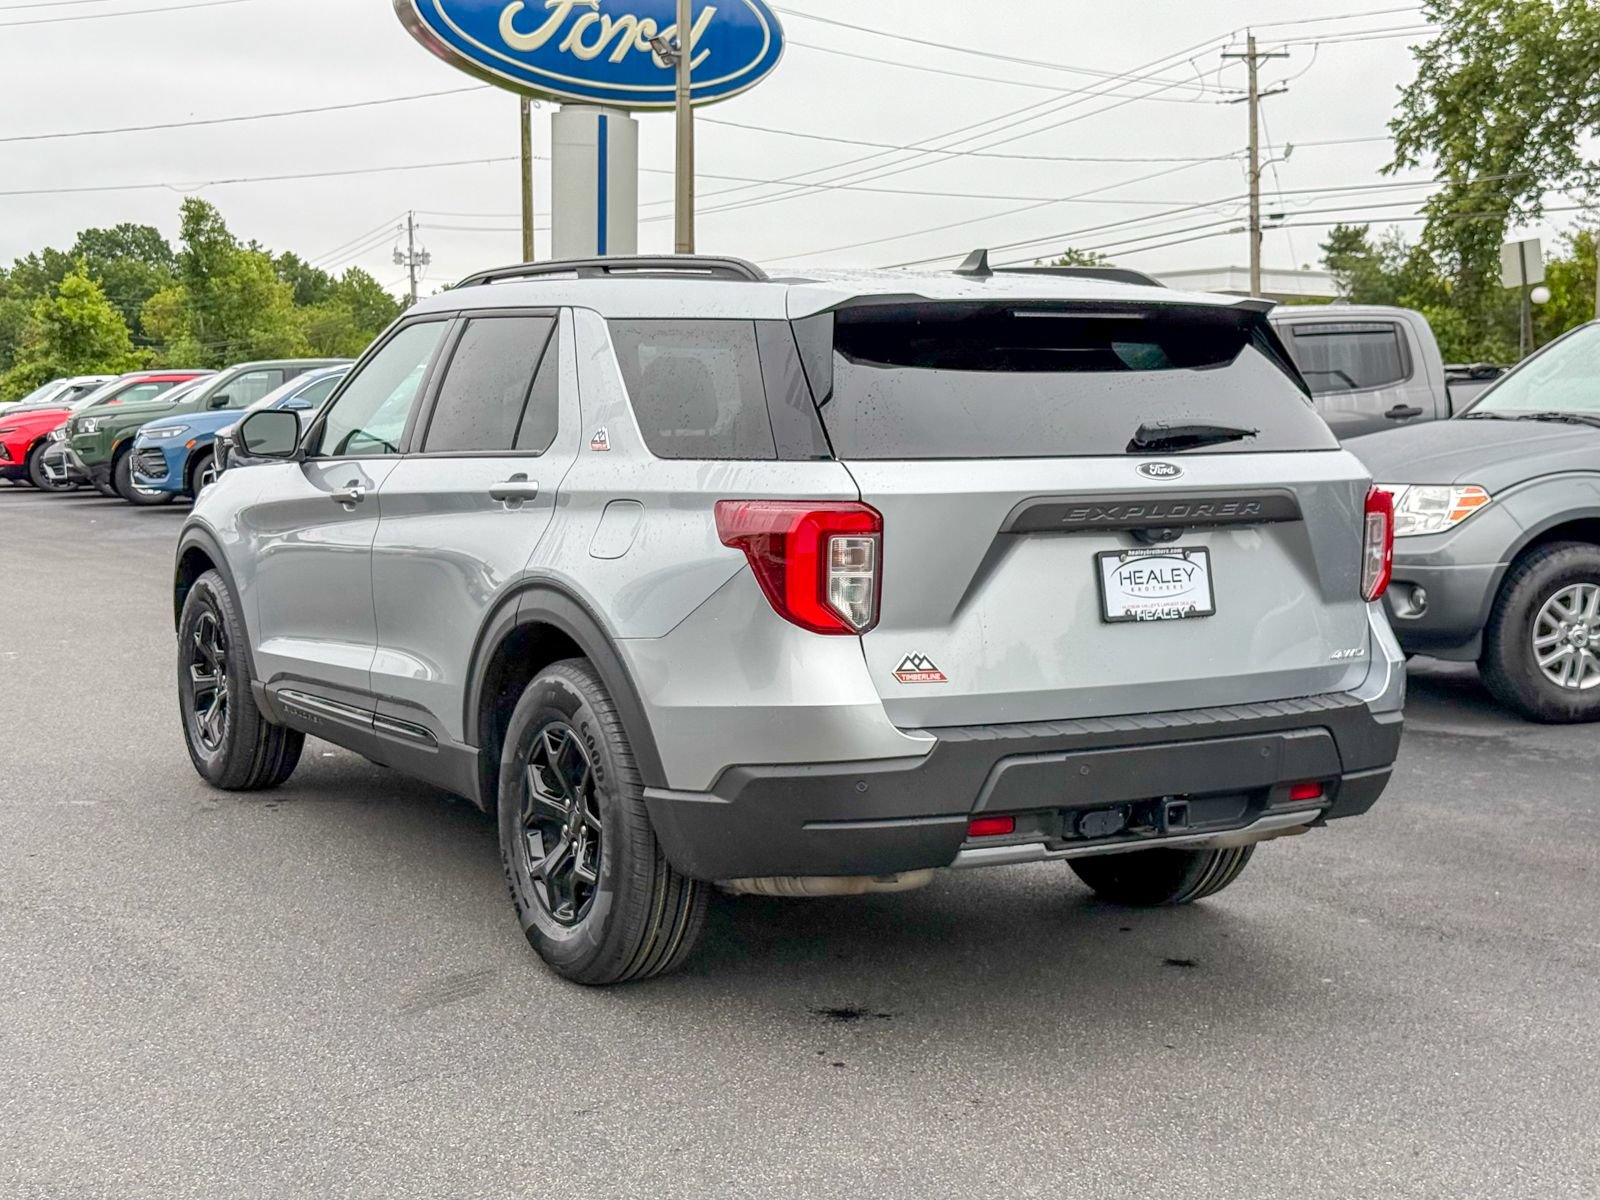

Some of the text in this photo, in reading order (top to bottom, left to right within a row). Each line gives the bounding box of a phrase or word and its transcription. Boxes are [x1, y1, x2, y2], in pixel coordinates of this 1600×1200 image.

[499, 0, 718, 70] Ford
[1149, 463, 1175, 475] Ford
[1062, 502, 1262, 522] EXPLORER
[1119, 567, 1195, 586] HEALEY
[1136, 607, 1186, 621] HEALEY
